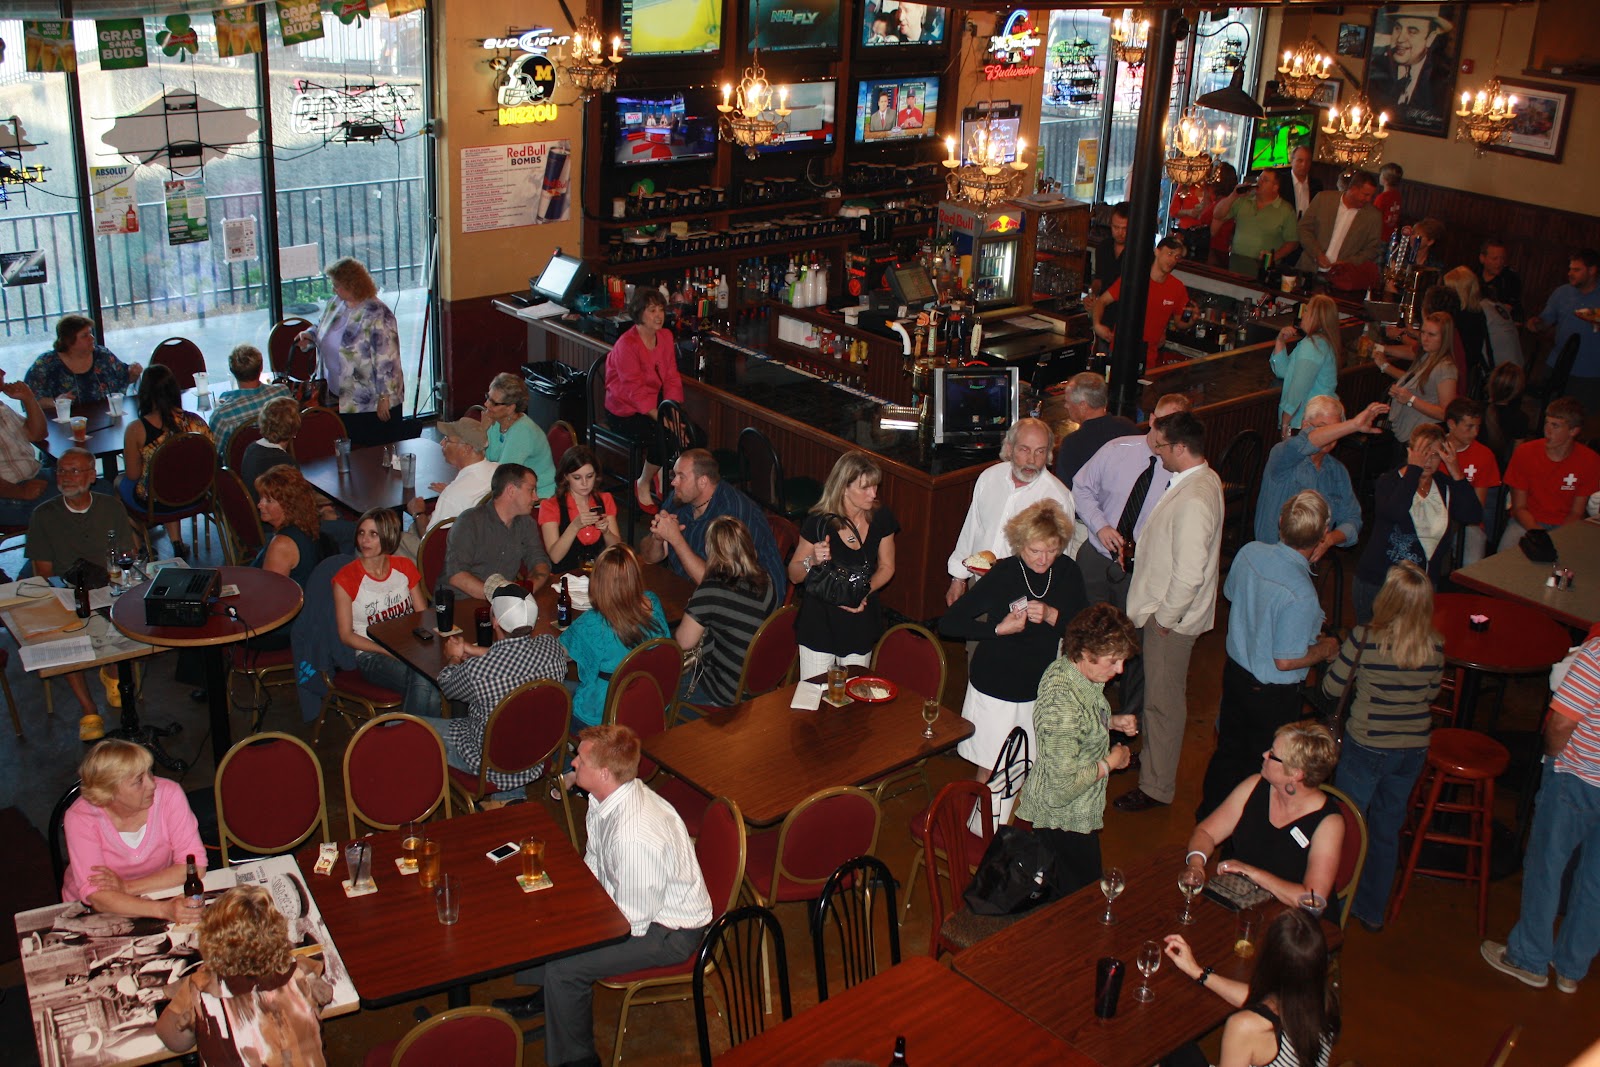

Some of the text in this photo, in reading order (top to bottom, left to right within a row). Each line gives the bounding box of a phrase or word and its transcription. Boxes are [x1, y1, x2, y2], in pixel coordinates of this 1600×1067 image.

[280, 3, 318, 19] GRAB
[100, 29, 142, 41] GRAB
[283, 20, 320, 36] BUDS
[102, 47, 144, 60] BUDS
[535, 65, 553, 81] M
[984, 64, 1040, 81] Budweiser
[498, 103, 558, 126] MIZZOU
[507, 145, 526, 158] Red
[527, 144, 546, 157] Bull
[511, 156, 542, 166] BOMBS
[95, 166, 128, 177] ABSOLUT
[939, 208, 974, 231] Red Bull
